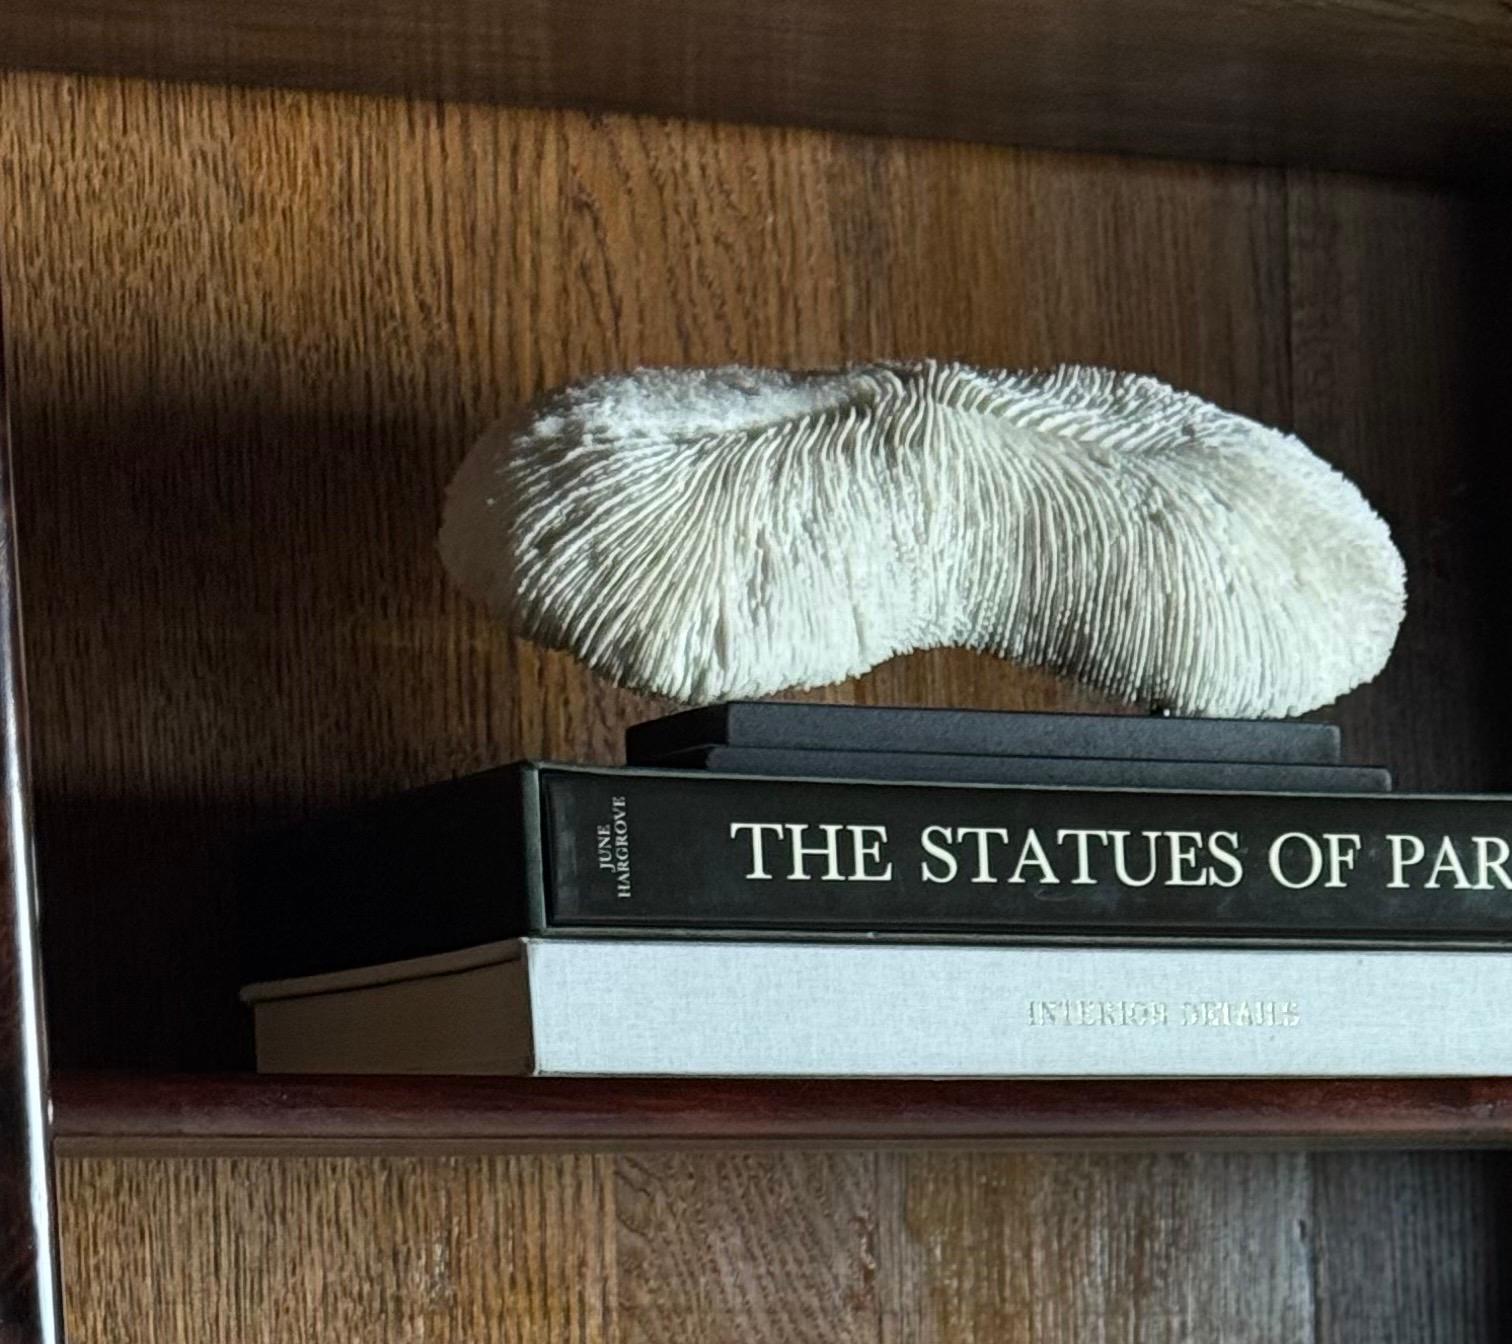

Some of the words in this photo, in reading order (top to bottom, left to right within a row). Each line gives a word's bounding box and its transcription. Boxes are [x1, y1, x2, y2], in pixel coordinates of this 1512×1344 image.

[597, 824, 616, 873] JUNE
[612, 797, 631, 897] HARGROVE
[730, 822, 894, 882] THE
[921, 825, 1243, 888] STATUES
[1269, 832, 1361, 889] OF
